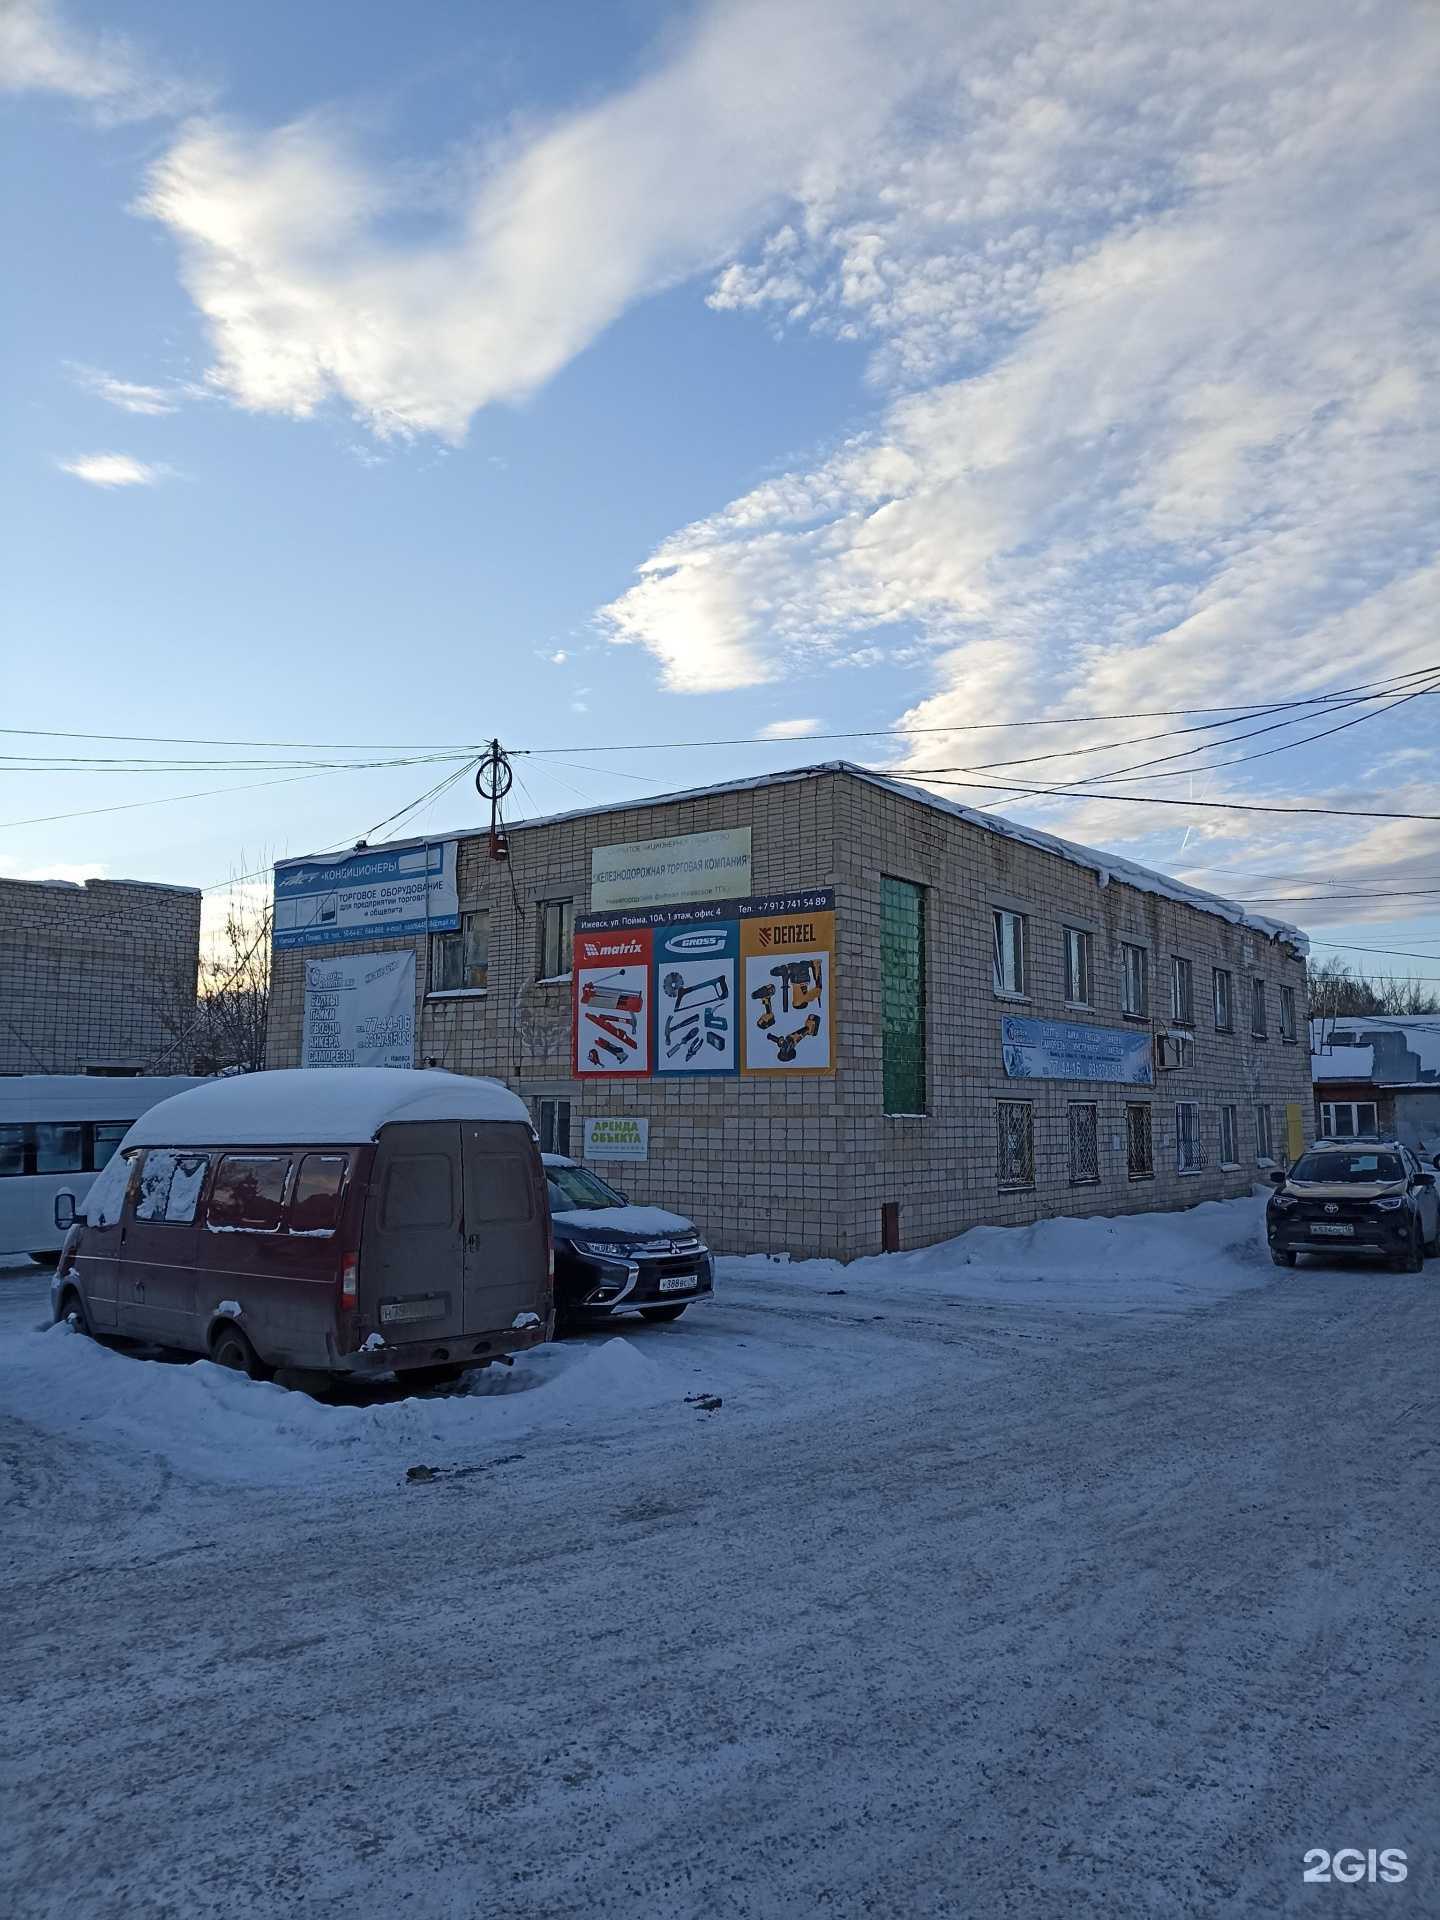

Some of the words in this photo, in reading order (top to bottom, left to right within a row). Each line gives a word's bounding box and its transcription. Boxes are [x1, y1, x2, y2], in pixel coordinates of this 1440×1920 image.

[323, 863, 397, 881] КОНДИЦИОНЕРЫ
[667, 859, 703, 873] ТОРГОВАЯ
[338, 889, 377, 903] ТОРГОВОЕ
[380, 880, 443, 897] ОБОРУДОВАНИЕ
[694, 909, 714, 920] офис
[715, 907, 721, 915] 4
[769, 901, 785, 910] 912
[786, 899, 801, 909] 741
[803, 898, 814, 908] 54
[815, 896, 826, 906] 89
[681, 936, 717, 947] GROSS
[773, 923, 817, 945] DENZEL
[600, 939, 642, 956] matrix
[308, 1048, 355, 1062] САМОРЕЗЫ
[594, 1121, 640, 1132] АРЕНДА
[591, 1132, 641, 1143] ОБЪЕКТА
